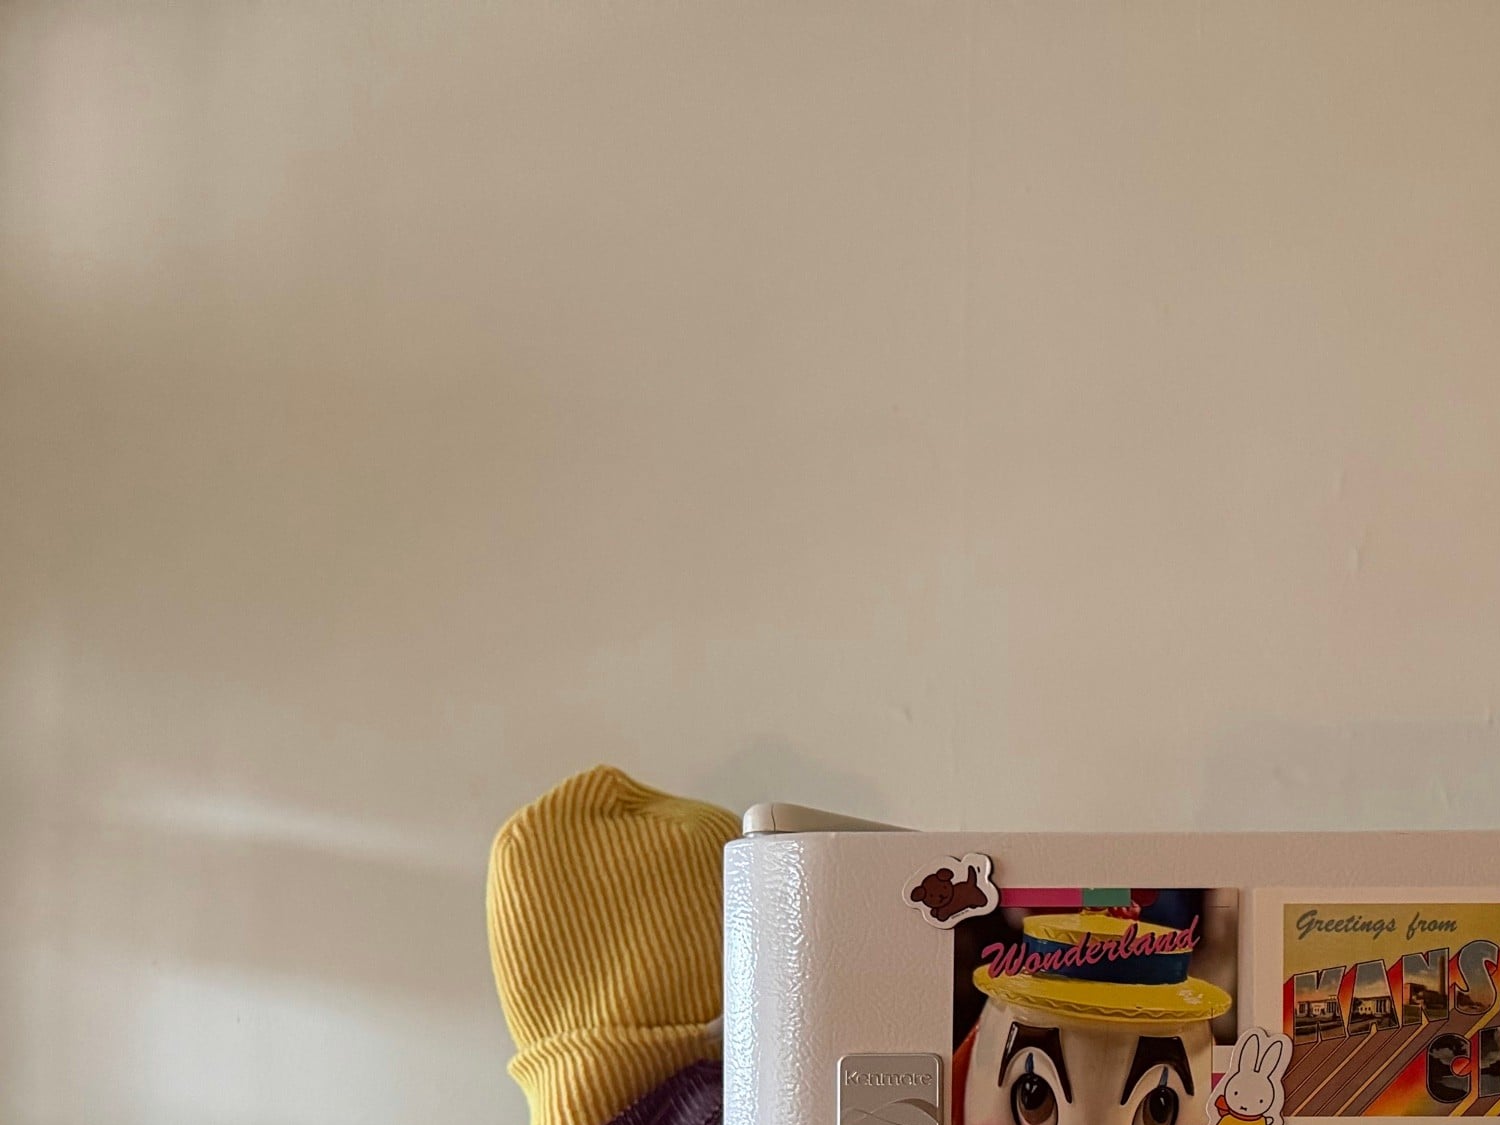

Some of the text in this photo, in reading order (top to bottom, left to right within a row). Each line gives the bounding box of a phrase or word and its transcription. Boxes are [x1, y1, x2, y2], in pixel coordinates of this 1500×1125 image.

[1296, 909, 1457, 940] Greetings from
[981, 915, 1199, 978] Wonderland
[844, 1069, 933, 1086] Kenmore
